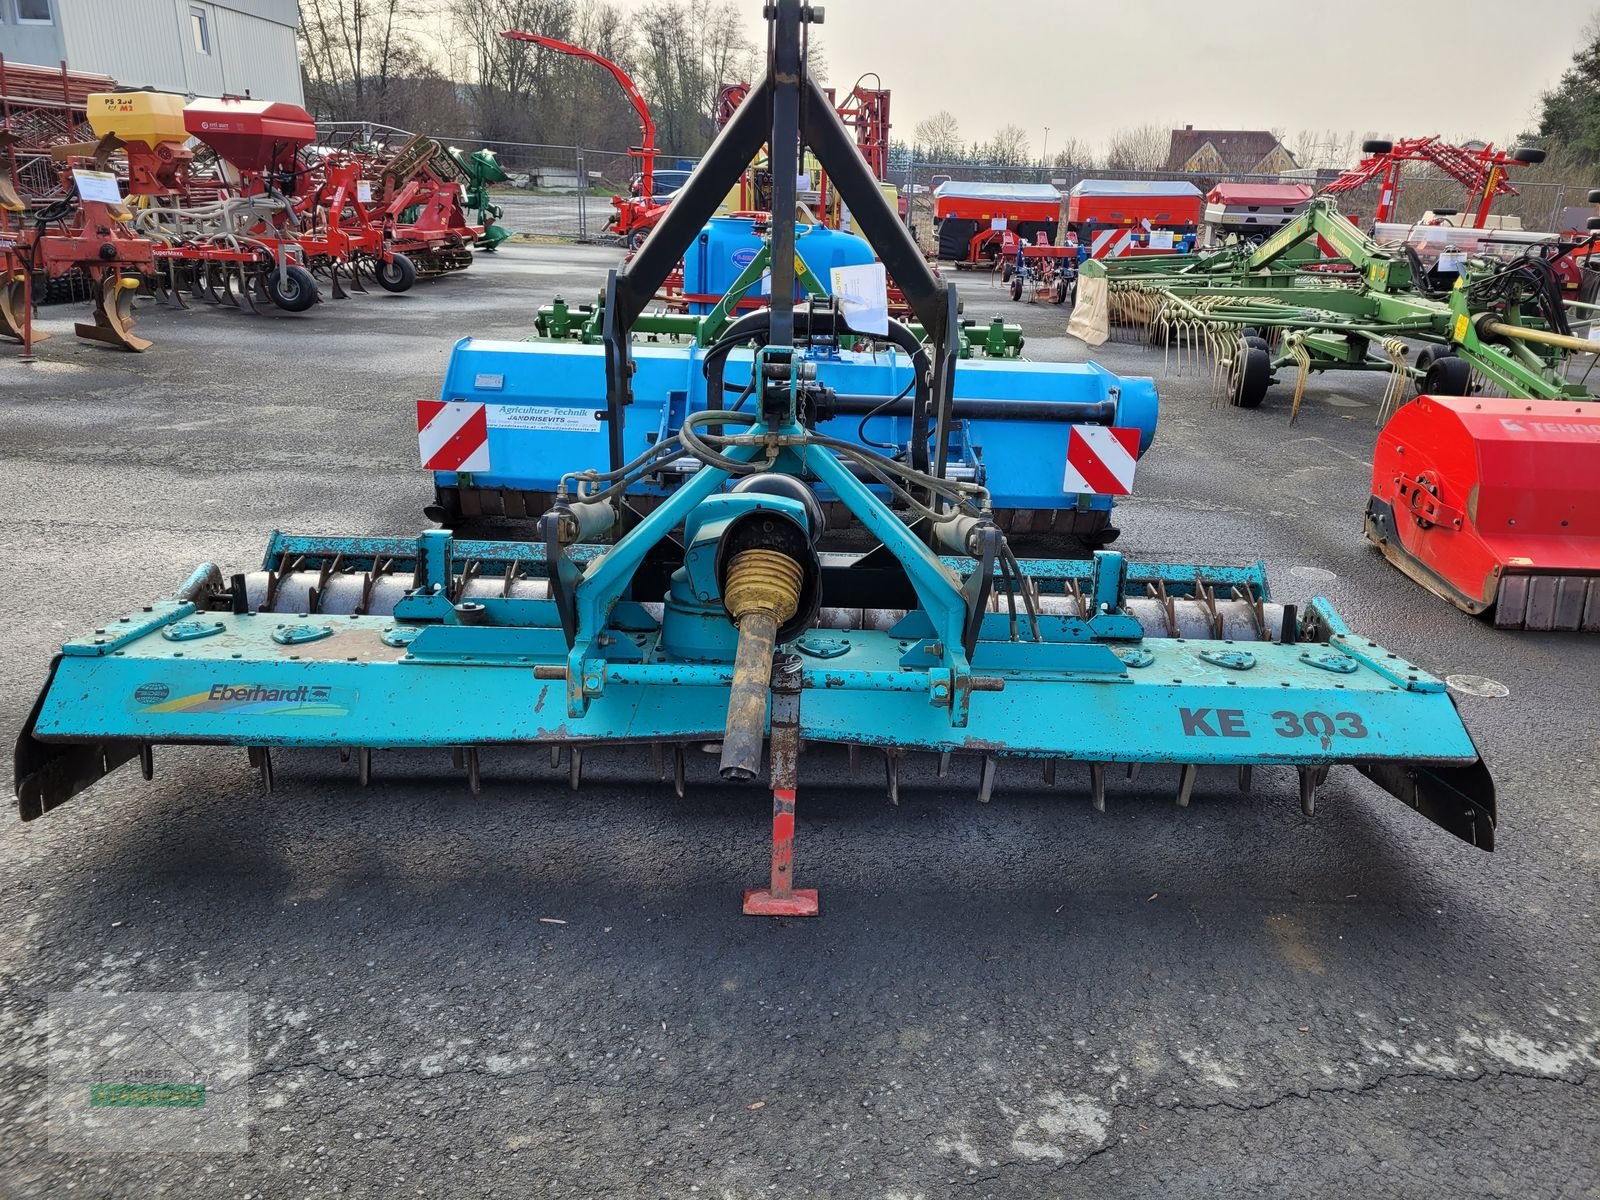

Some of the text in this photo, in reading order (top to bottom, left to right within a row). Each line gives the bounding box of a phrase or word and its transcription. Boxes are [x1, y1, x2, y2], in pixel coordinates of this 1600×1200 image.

[152, 249, 183, 257] SuperMaxx
[499, 405, 588, 417] Agriculture-Technik
[507, 414, 565, 423] JANDRISEVITS
[208, 683, 308, 703] Eberhardt
[1178, 707, 1368, 739] KE 303
